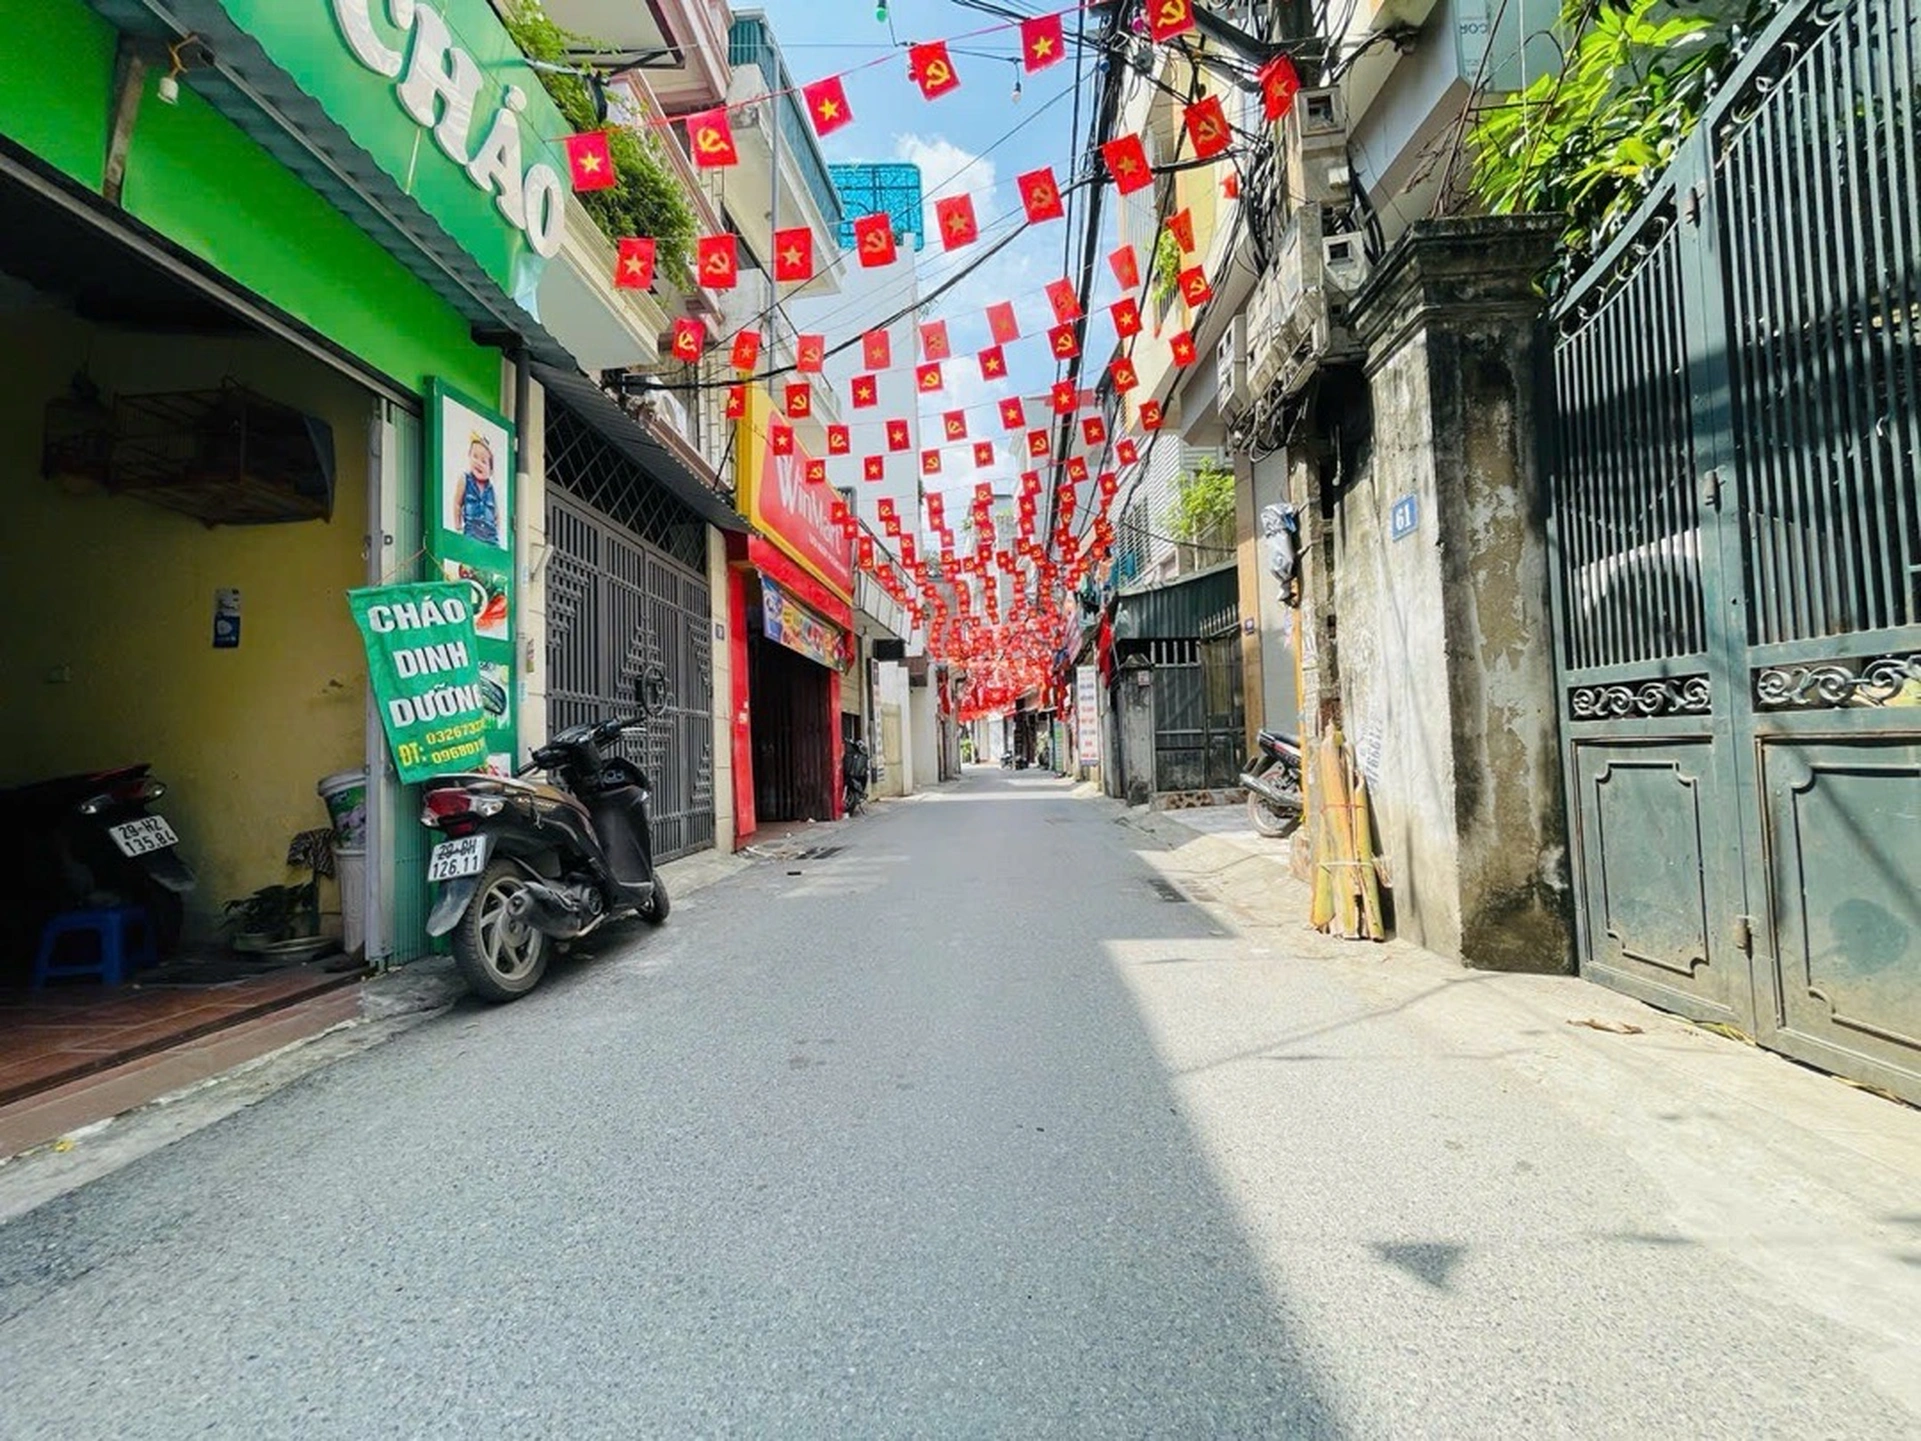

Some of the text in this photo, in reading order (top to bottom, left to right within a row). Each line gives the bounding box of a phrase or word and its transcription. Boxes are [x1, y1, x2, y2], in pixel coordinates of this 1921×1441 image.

[775, 454, 846, 556] WinMar
[1396, 502, 1411, 531] 61
[367, 595, 467, 633] CHÁO
[393, 640, 469, 680] DINH
[118, 818, 162, 839] 29-H2
[433, 855, 478, 879] 126.11
